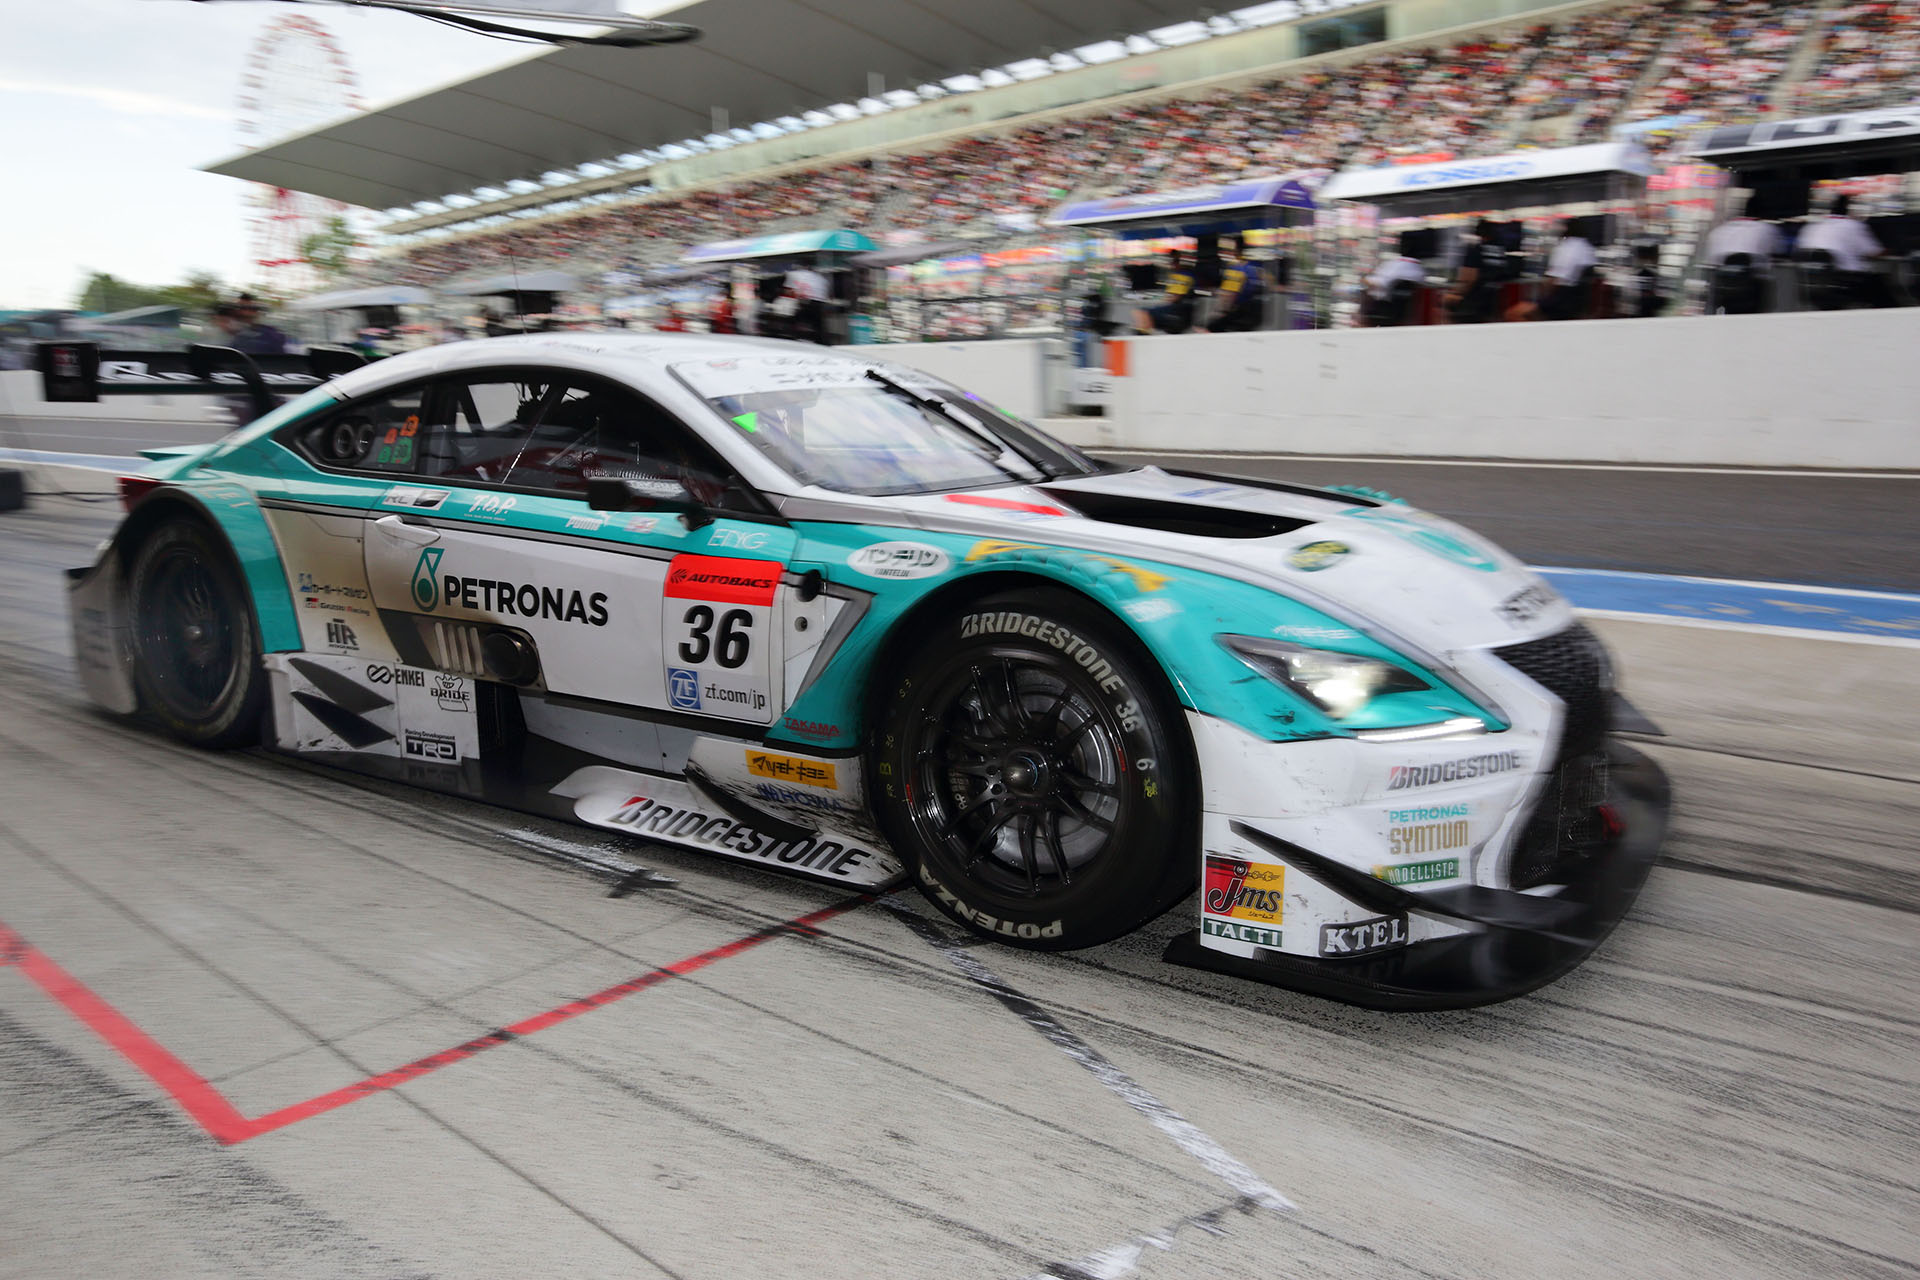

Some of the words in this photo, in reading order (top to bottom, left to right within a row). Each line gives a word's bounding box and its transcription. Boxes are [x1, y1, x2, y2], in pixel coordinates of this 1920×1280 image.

[688, 573, 773, 588] AUTOBACS
[444, 575, 608, 627] PETRONAS
[678, 604, 753, 669] 36
[961, 611, 1125, 695] BRIDGESTONE
[395, 668, 425, 688] ENKEI
[671, 676, 698, 701] ZF
[430, 688, 470, 701] BRIDE
[705, 683, 766, 710] zf.com/jp
[405, 728, 421, 737] Racing
[422, 731, 455, 741] Development
[407, 739, 454, 759] TRD
[1387, 751, 1521, 790] BRIDGESTONE
[1389, 803, 1470, 824] PETRONAS
[605, 796, 871, 875] BRIDGESTONE
[1390, 819, 1469, 856] SYNTIUM
[1387, 861, 1455, 884] MODELLISTA
[919, 863, 1064, 940] POTENZA
[1207, 920, 1279, 946] TACTI
[1324, 918, 1406, 953] KTEL
